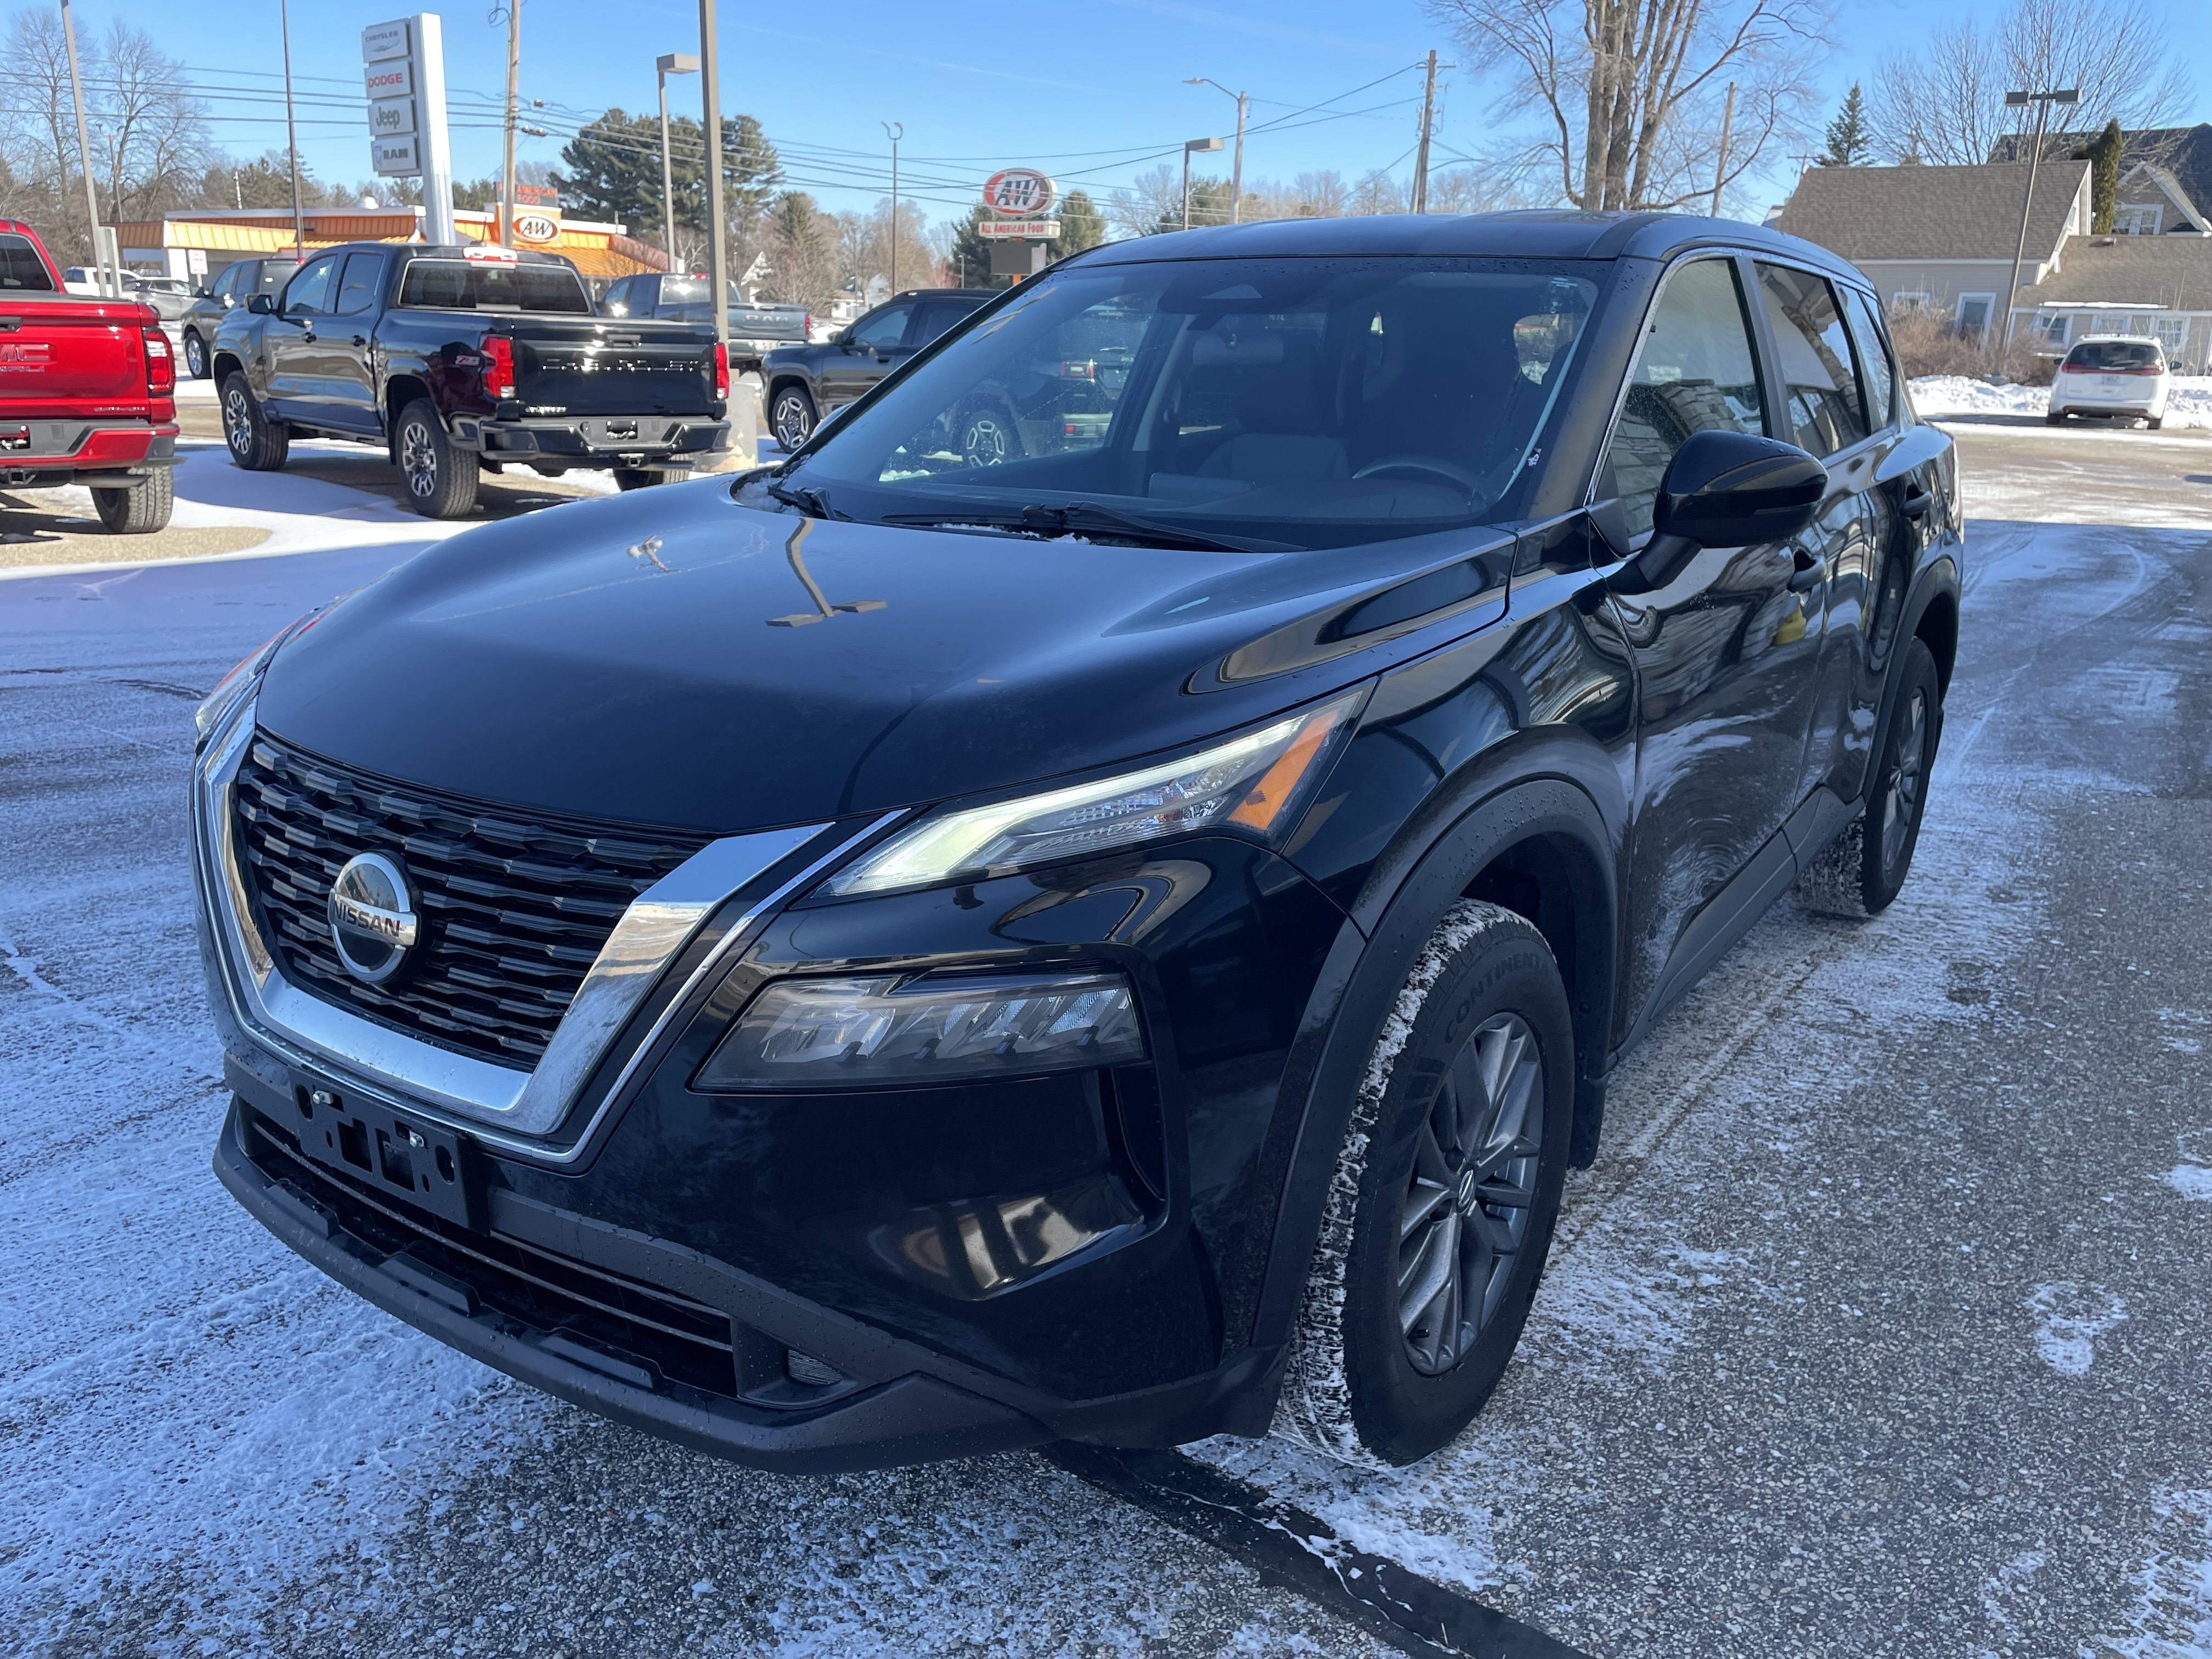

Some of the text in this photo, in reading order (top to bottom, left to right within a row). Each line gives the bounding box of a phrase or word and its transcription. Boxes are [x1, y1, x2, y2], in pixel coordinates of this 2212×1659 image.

[365, 30, 398, 42] CHRYSLER
[368, 73, 403, 88] DODGE
[376, 106, 400, 129] Jeep
[383, 148, 409, 159] RAM
[994, 180, 1039, 206] A&W
[521, 221, 552, 235] A&W
[981, 222, 1045, 233] ALL AMERICAN FOOD
[744, 314, 790, 323] RAM
[0, 343, 49, 362] MC
[334, 900, 400, 937] NISSAN
